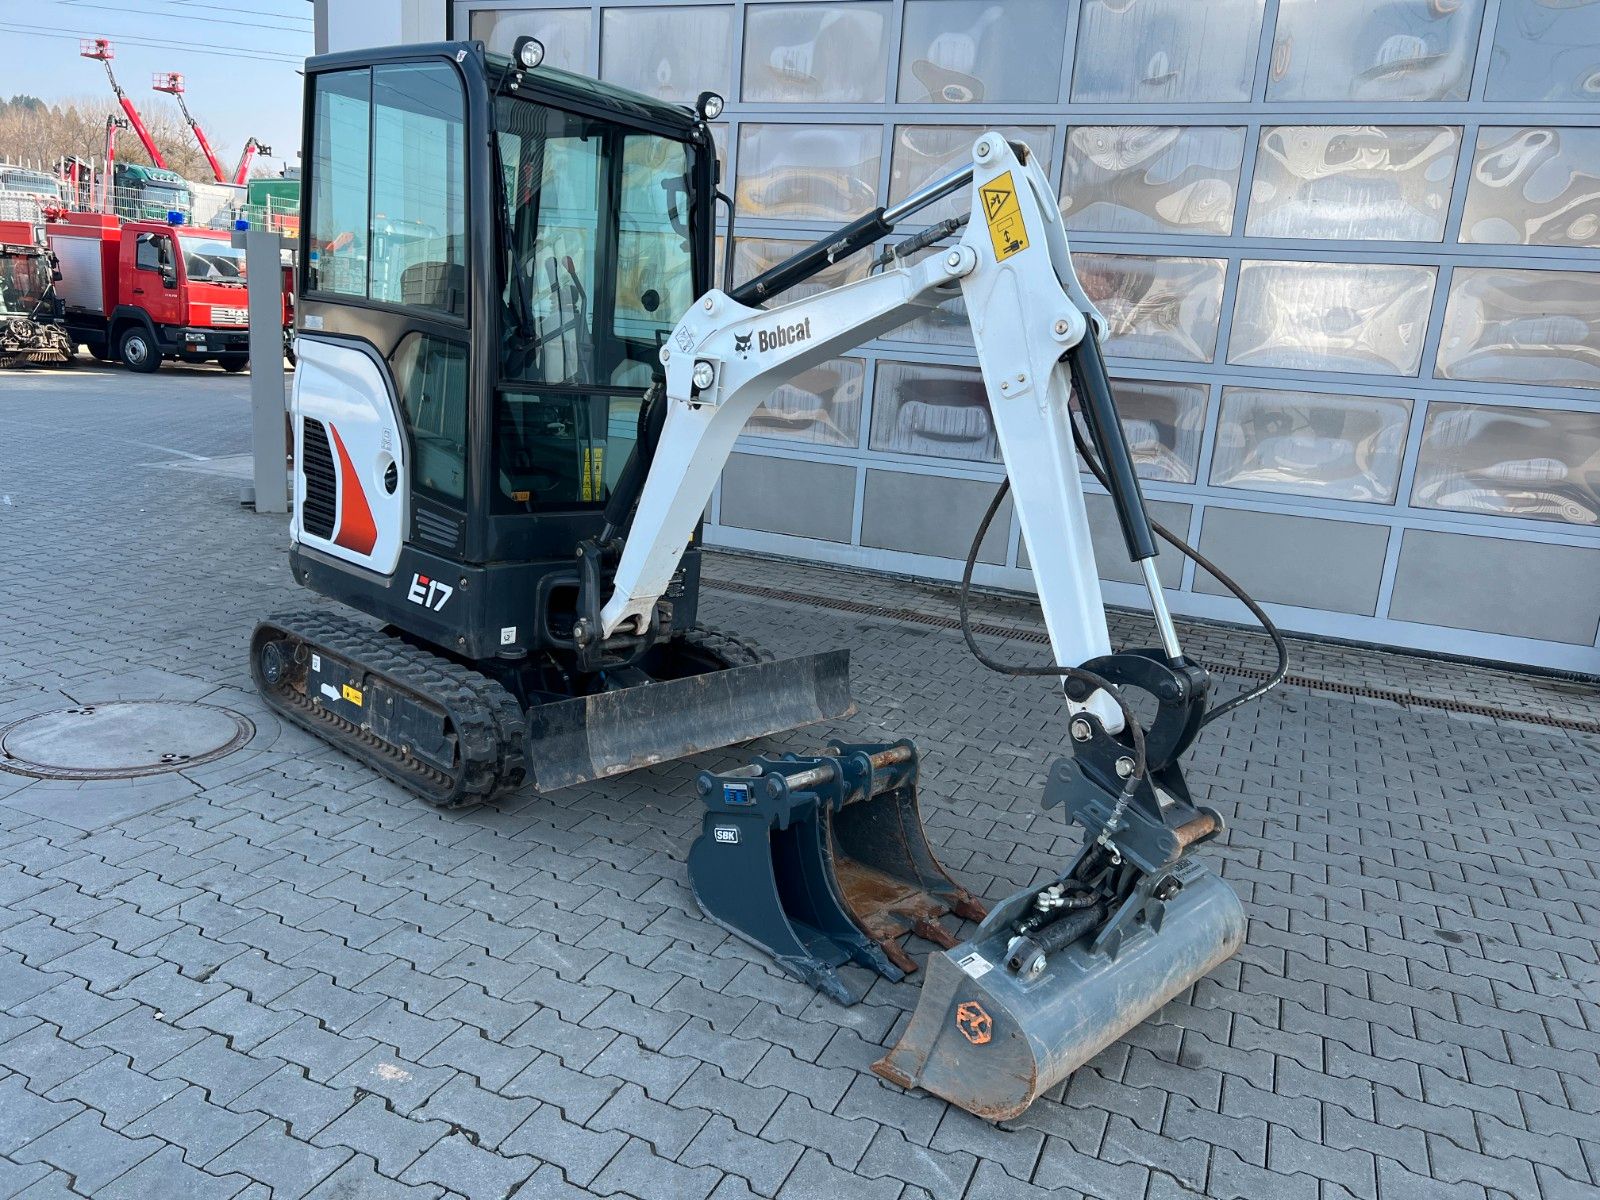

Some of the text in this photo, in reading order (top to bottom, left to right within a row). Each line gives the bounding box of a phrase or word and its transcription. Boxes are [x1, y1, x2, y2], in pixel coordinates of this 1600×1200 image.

[758, 317, 812, 353] Bobcat
[407, 573, 454, 612] E17
[717, 831, 735, 841] SBK
